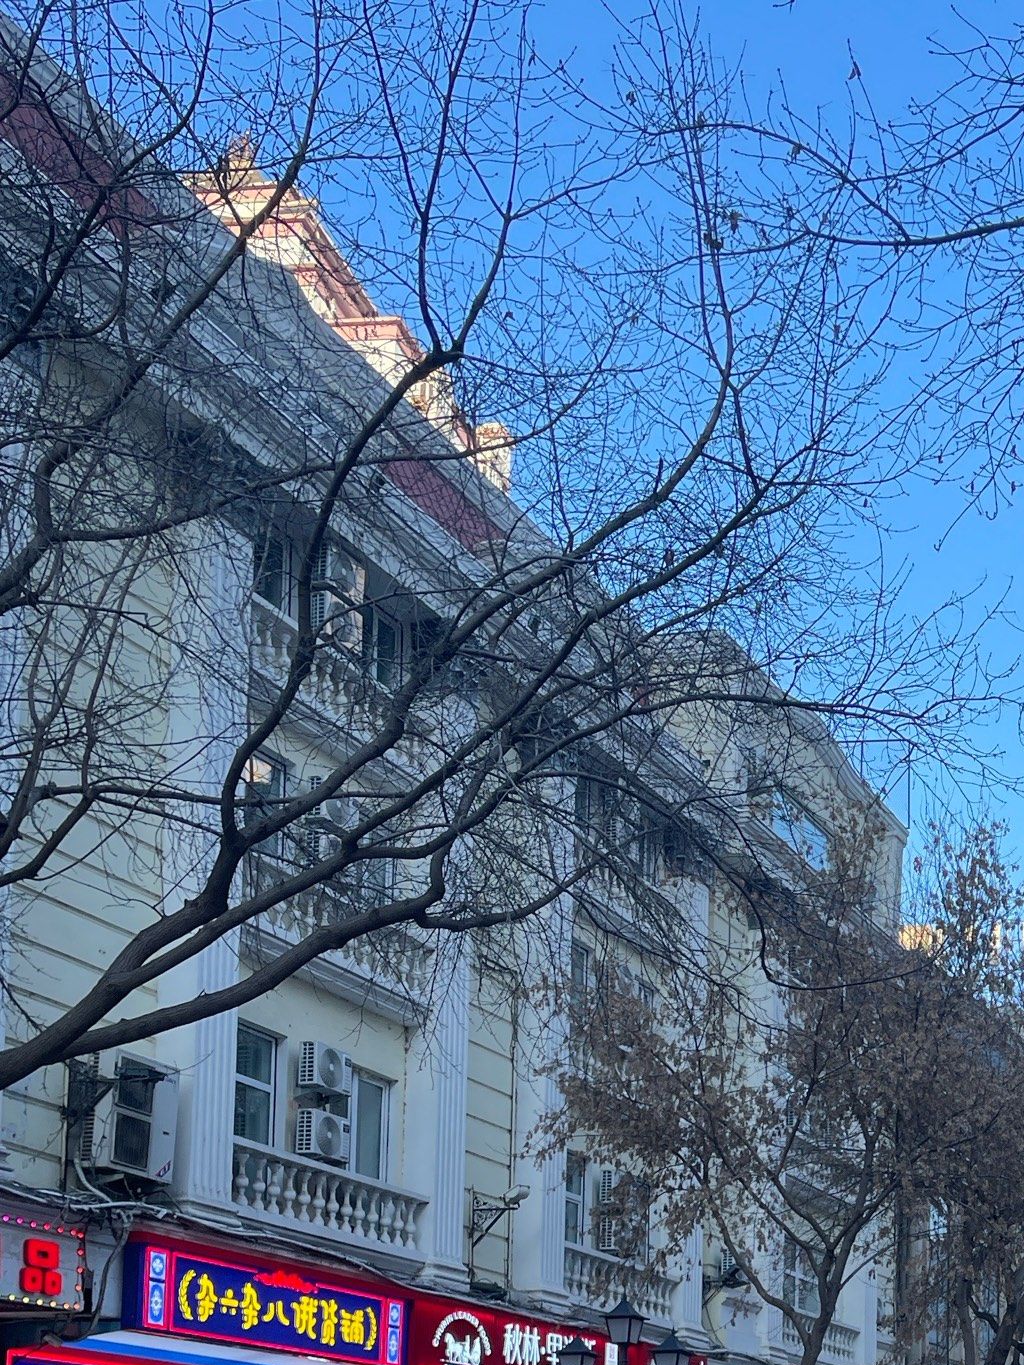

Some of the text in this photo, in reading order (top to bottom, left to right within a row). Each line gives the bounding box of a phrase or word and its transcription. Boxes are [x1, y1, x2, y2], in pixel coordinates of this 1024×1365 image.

[19, 1238, 62, 1296] 品
[196, 1273, 364, 1347] 杂六杂八俄货铺
[453, 1310, 479, 1328] LEADER
